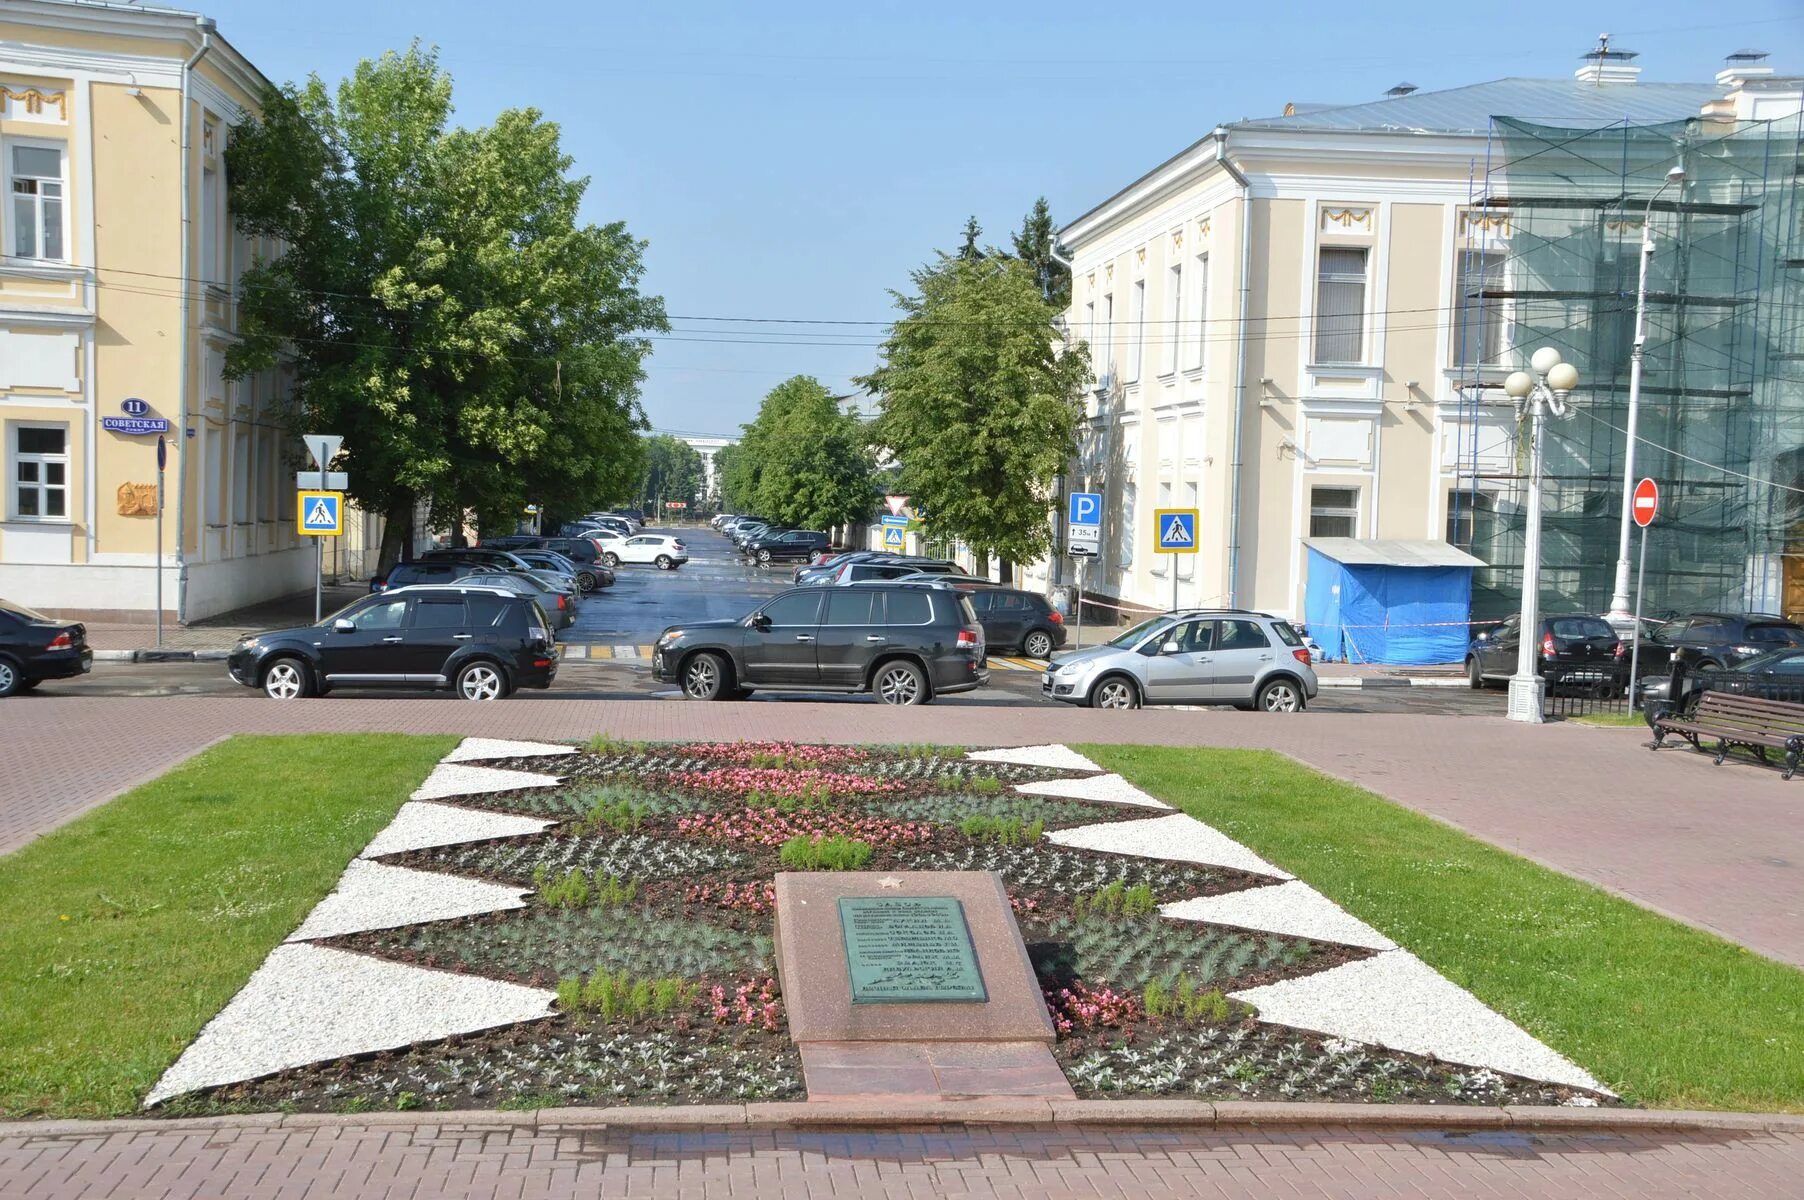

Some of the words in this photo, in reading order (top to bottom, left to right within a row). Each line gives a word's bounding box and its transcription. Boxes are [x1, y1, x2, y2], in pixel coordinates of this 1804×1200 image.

[128, 401, 142, 412] 11
[105, 418, 164, 429] СОВЕТСКАЯ
[1077, 497, 1095, 522] P
